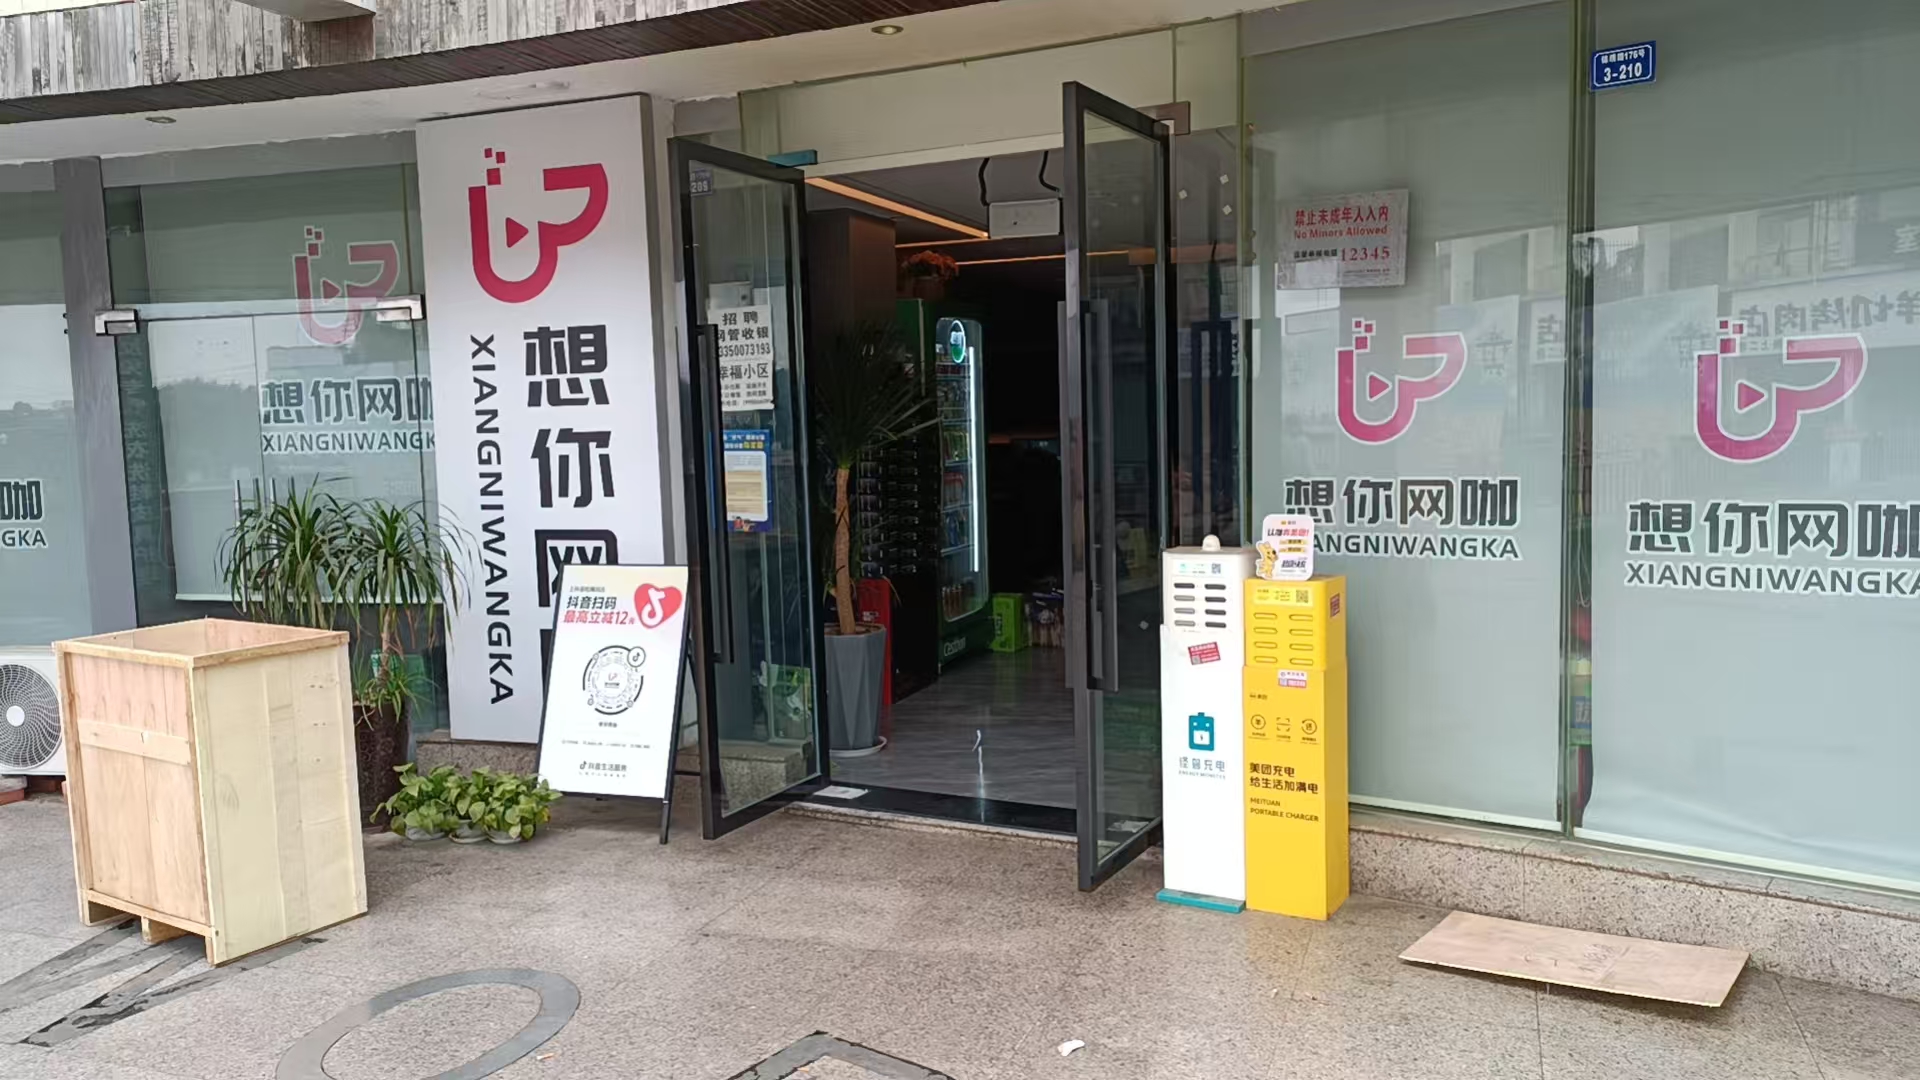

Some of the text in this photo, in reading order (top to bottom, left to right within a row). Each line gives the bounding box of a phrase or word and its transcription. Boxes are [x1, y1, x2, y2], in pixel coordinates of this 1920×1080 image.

[1604, 62, 1642, 82] 3-210
[1294, 206, 1389, 227] 禁止未成年人入内
[1294, 225, 1388, 239] No Minors Allowed
[1341, 246, 1390, 261] 12345
[722, 311, 758, 326] 招聘
[719, 342, 771, 358] 3350073193
[262, 431, 435, 452] XIANGNIWANGK
[523, 324, 619, 690] 想你网
[1285, 479, 1519, 527] 想你网咖
[470, 334, 514, 705] XIANGNIWANGKA
[1629, 501, 1920, 558] 想你网咖
[1312, 534, 1519, 559] ANGNIWANGKA
[566, 595, 617, 609] 抖音扫码
[1179, 756, 1225, 773] 怪兽充电
[1249, 762, 1295, 777] 美团充电
[1249, 776, 1319, 795] 给生活加满电
[1250, 797, 1281, 807] MEITUAN
[1250, 808, 1319, 822] PORTABLE CHARGER
